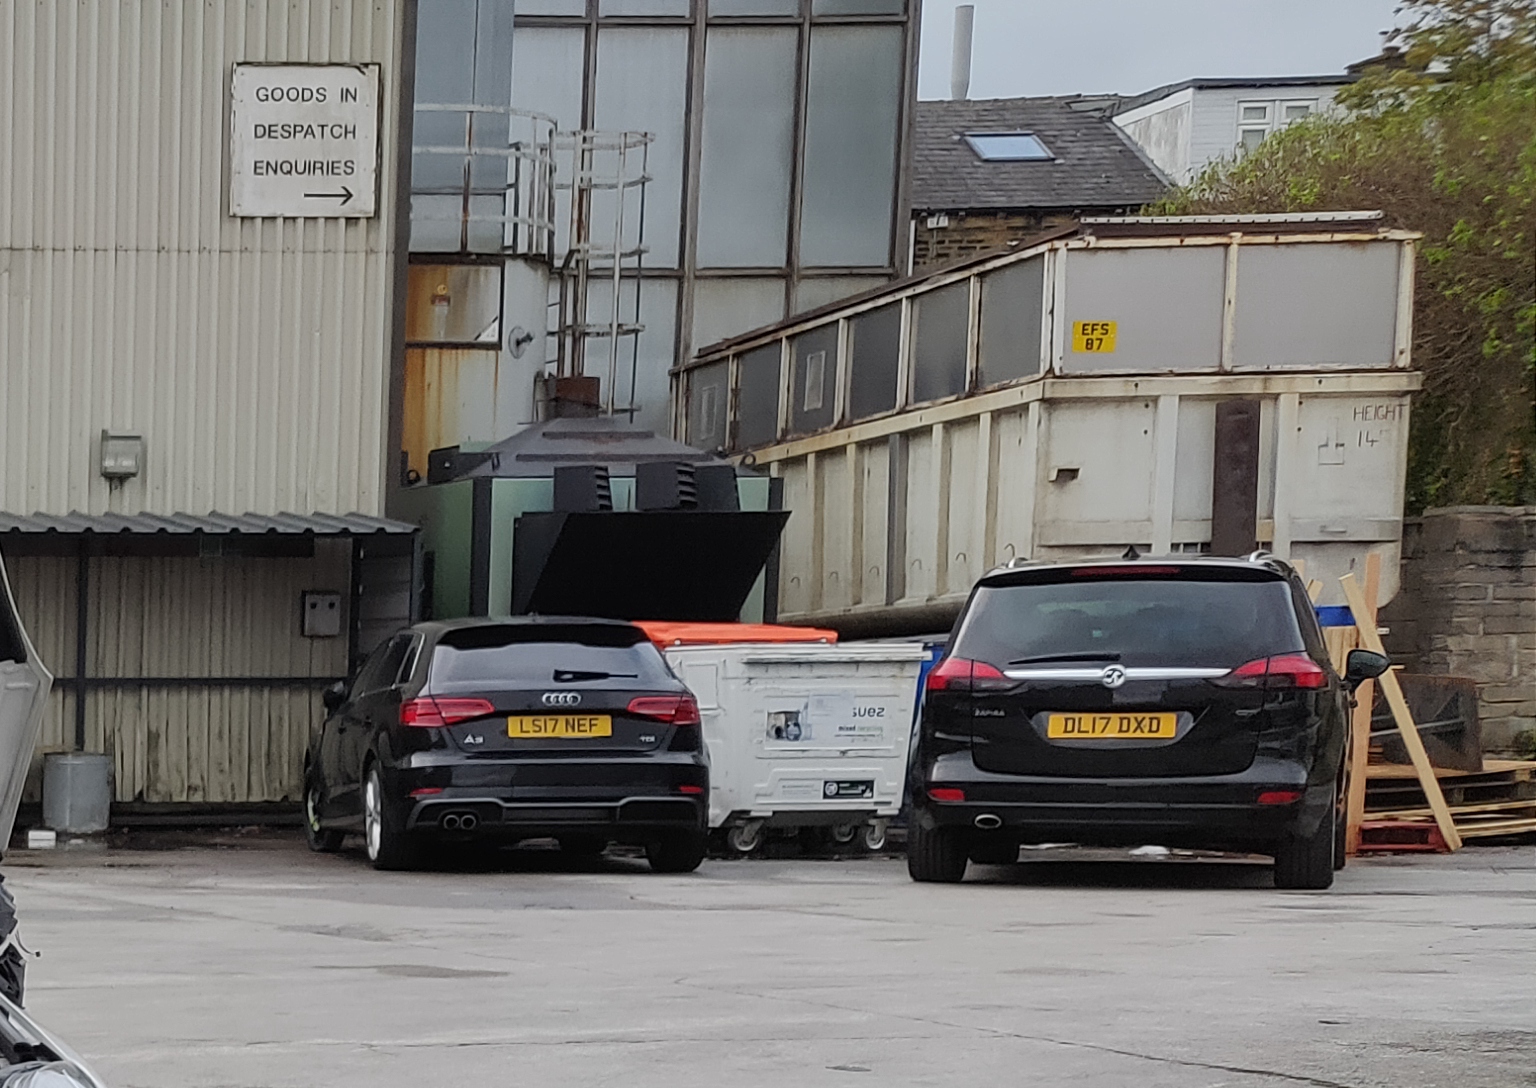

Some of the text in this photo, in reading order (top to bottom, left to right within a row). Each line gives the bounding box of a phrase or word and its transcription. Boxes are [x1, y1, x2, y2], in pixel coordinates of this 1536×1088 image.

[255, 86, 358, 103] GOODS IN
[253, 124, 357, 140] DESPATCH
[253, 160, 355, 176] ENQUIRIES
[1081, 322, 1110, 336] EFS
[1085, 337, 1104, 351] 87
[1353, 403, 1408, 421] HEIGHT
[520, 717, 599, 734] LS17 NEF
[1062, 716, 1161, 734] DL17 DXD
